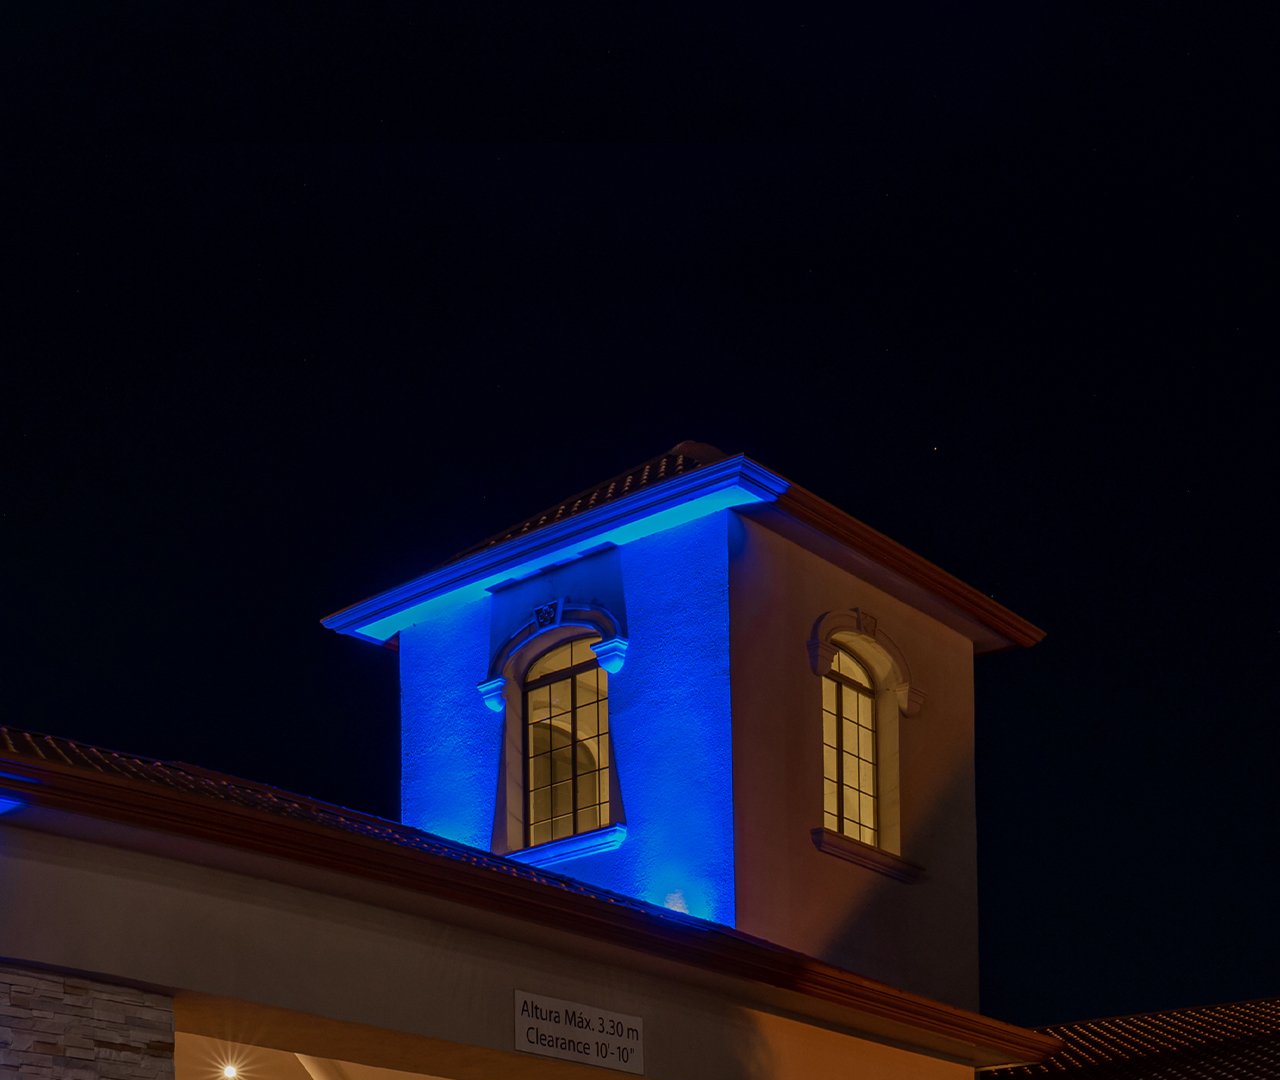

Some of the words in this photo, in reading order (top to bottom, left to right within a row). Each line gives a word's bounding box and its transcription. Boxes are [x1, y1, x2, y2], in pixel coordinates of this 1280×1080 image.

[521, 1000, 561, 1024] Altura
[564, 1009, 595, 1031] Máx.
[598, 1017, 624, 1038] 3.30
[627, 1027, 639, 1041] m
[526, 1026, 591, 1056] Clearance
